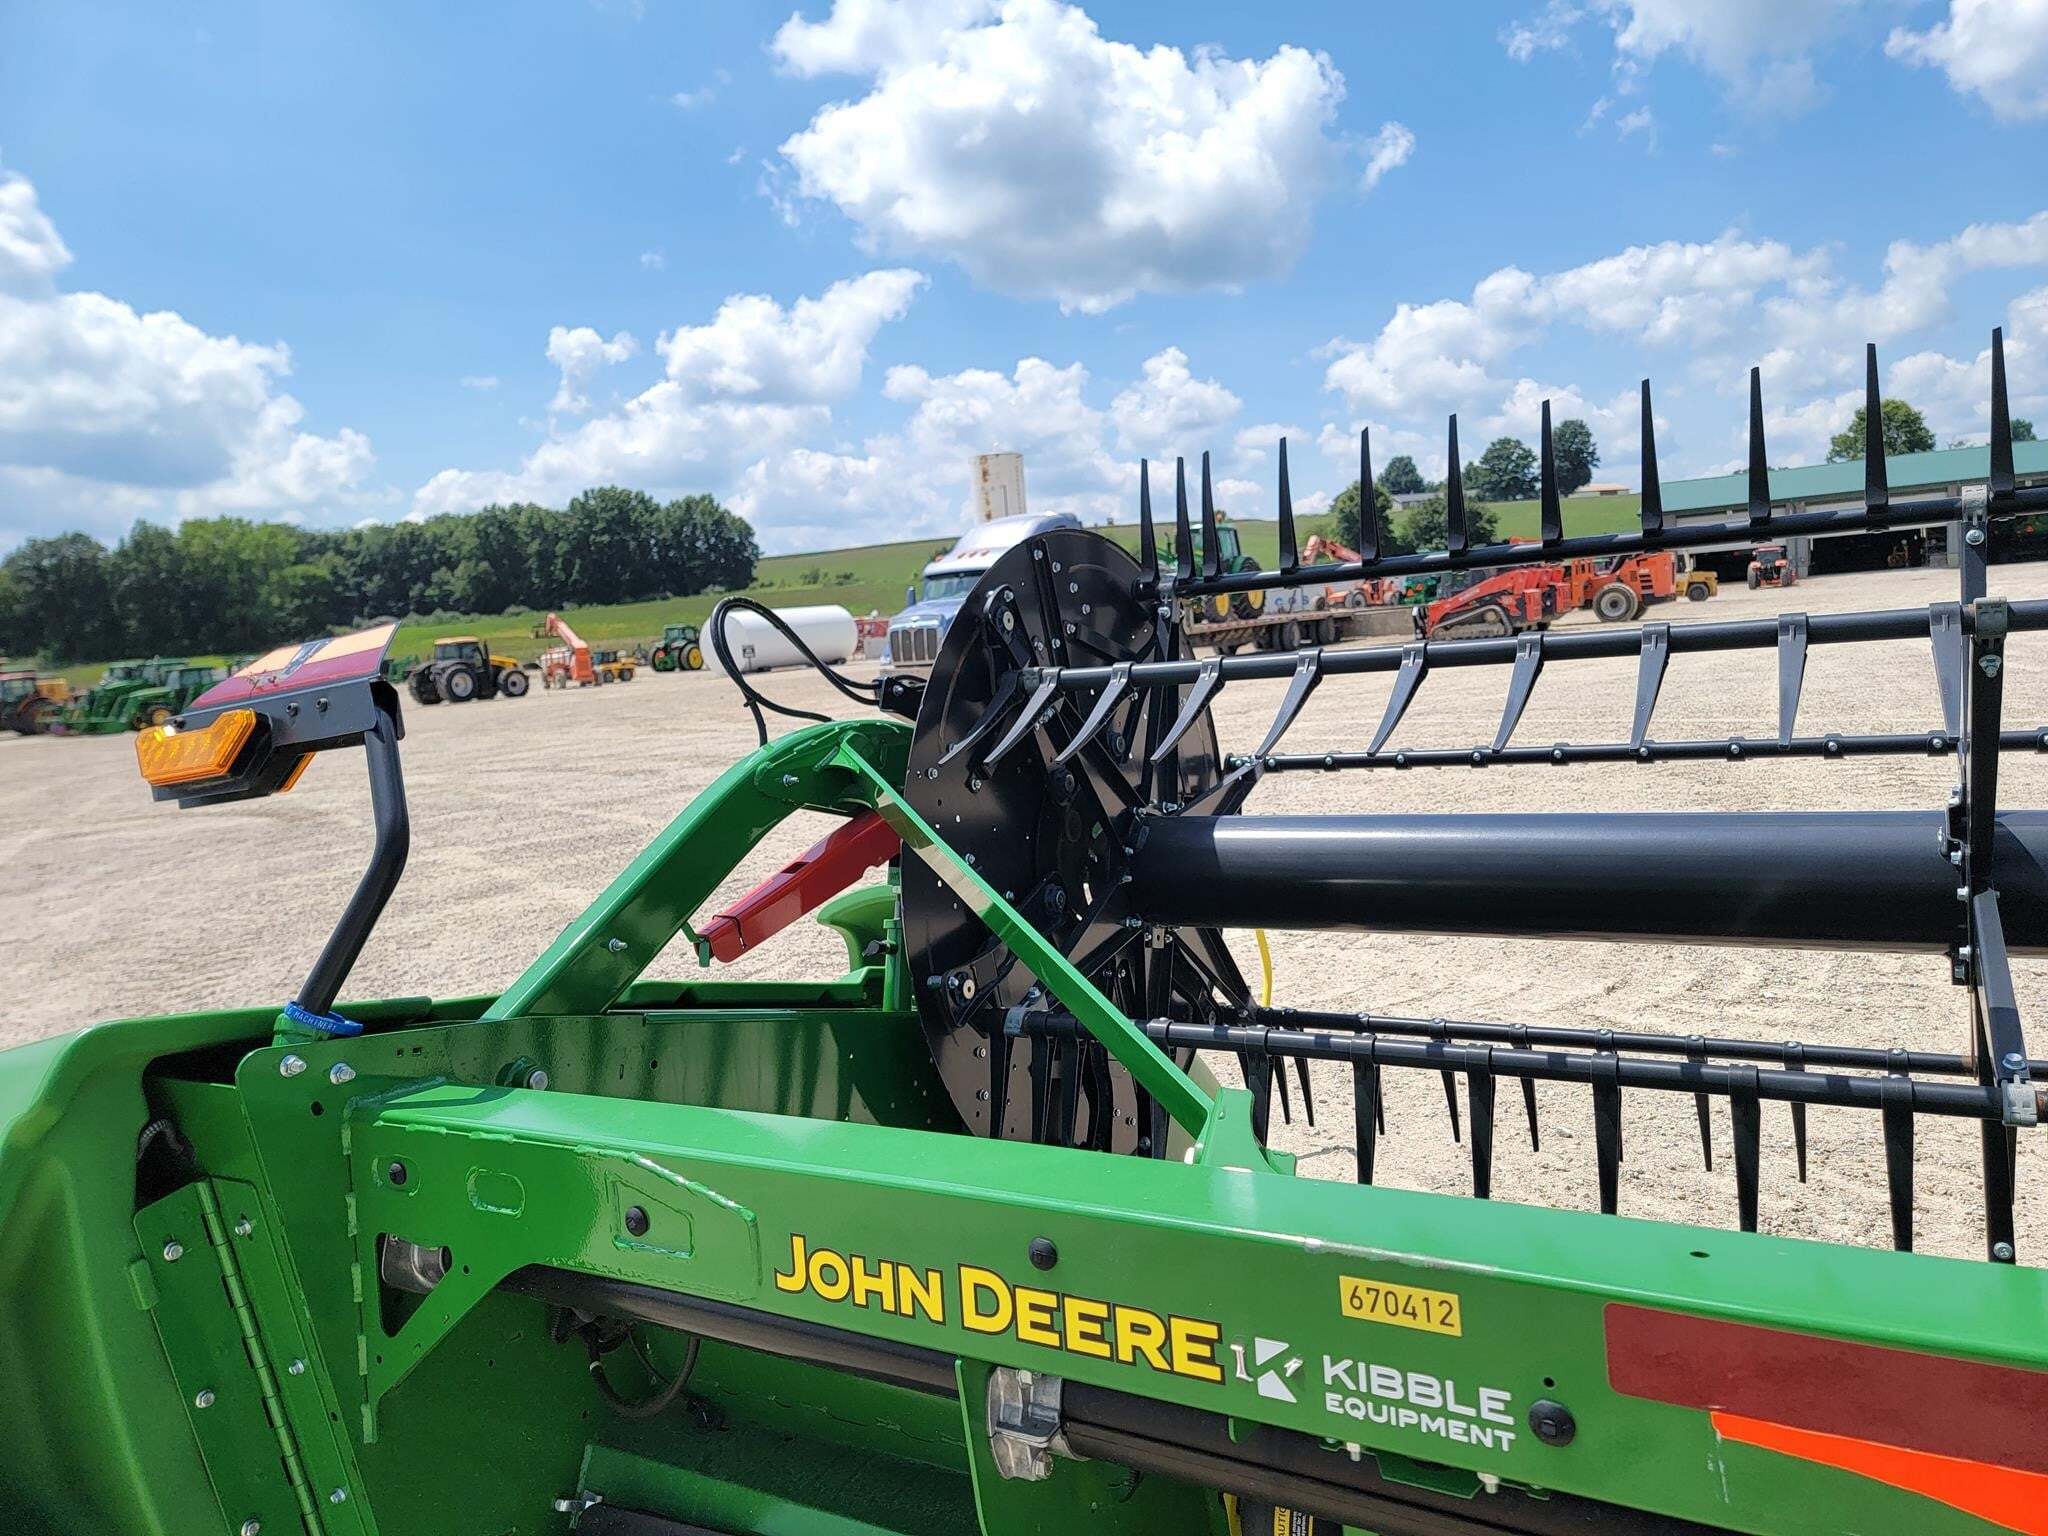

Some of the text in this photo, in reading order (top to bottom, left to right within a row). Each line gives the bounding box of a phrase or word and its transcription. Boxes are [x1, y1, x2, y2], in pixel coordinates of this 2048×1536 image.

[774, 1233, 1225, 1385] JOHN DEERE
[1350, 1285, 1455, 1328] 670412
[1322, 1354, 1516, 1426] KIBBLE
[1324, 1392, 1517, 1452] EQUIPMENT
